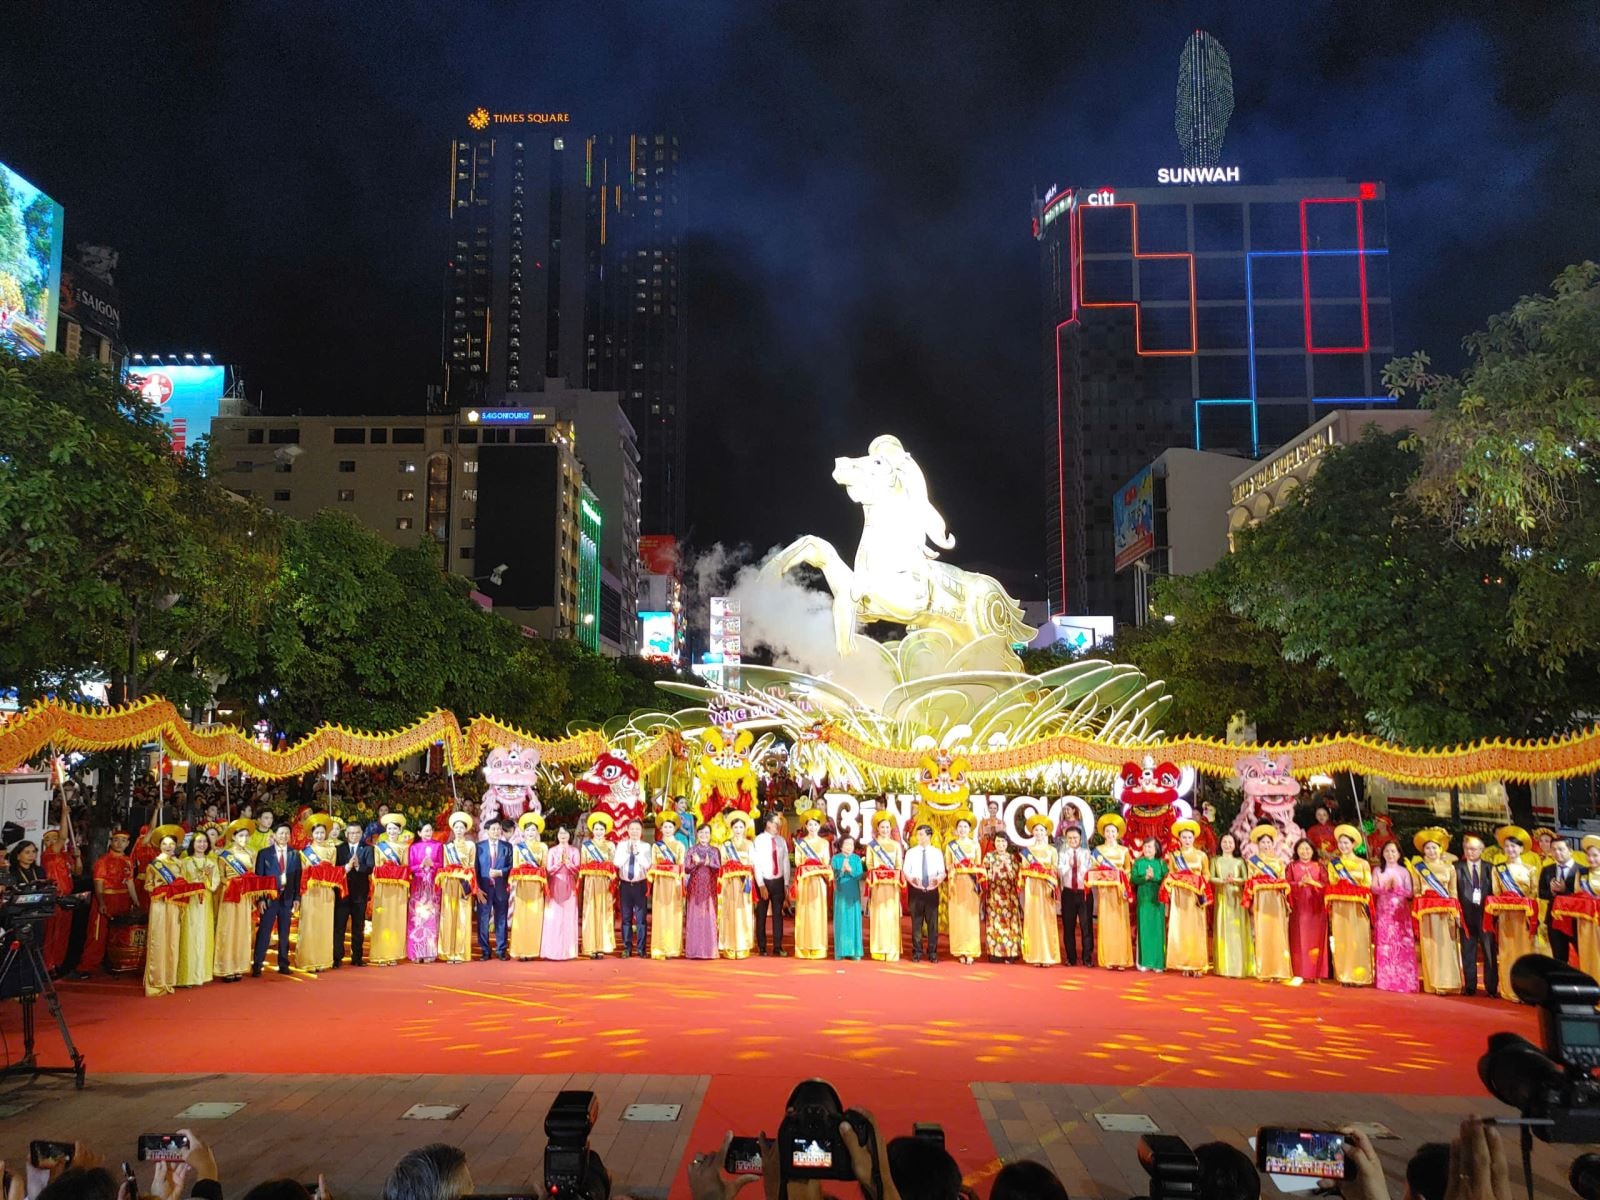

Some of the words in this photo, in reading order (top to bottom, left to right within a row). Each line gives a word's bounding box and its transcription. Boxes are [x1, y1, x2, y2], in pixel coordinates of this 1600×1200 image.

[493, 113, 525, 123] TIMES
[527, 113, 570, 123] SQUARE
[1157, 166, 1240, 183] SUNWAH
[1087, 190, 1115, 206] citi
[81, 290, 120, 321] SAIGON
[481, 412, 530, 420] SAIGONTOURIST
